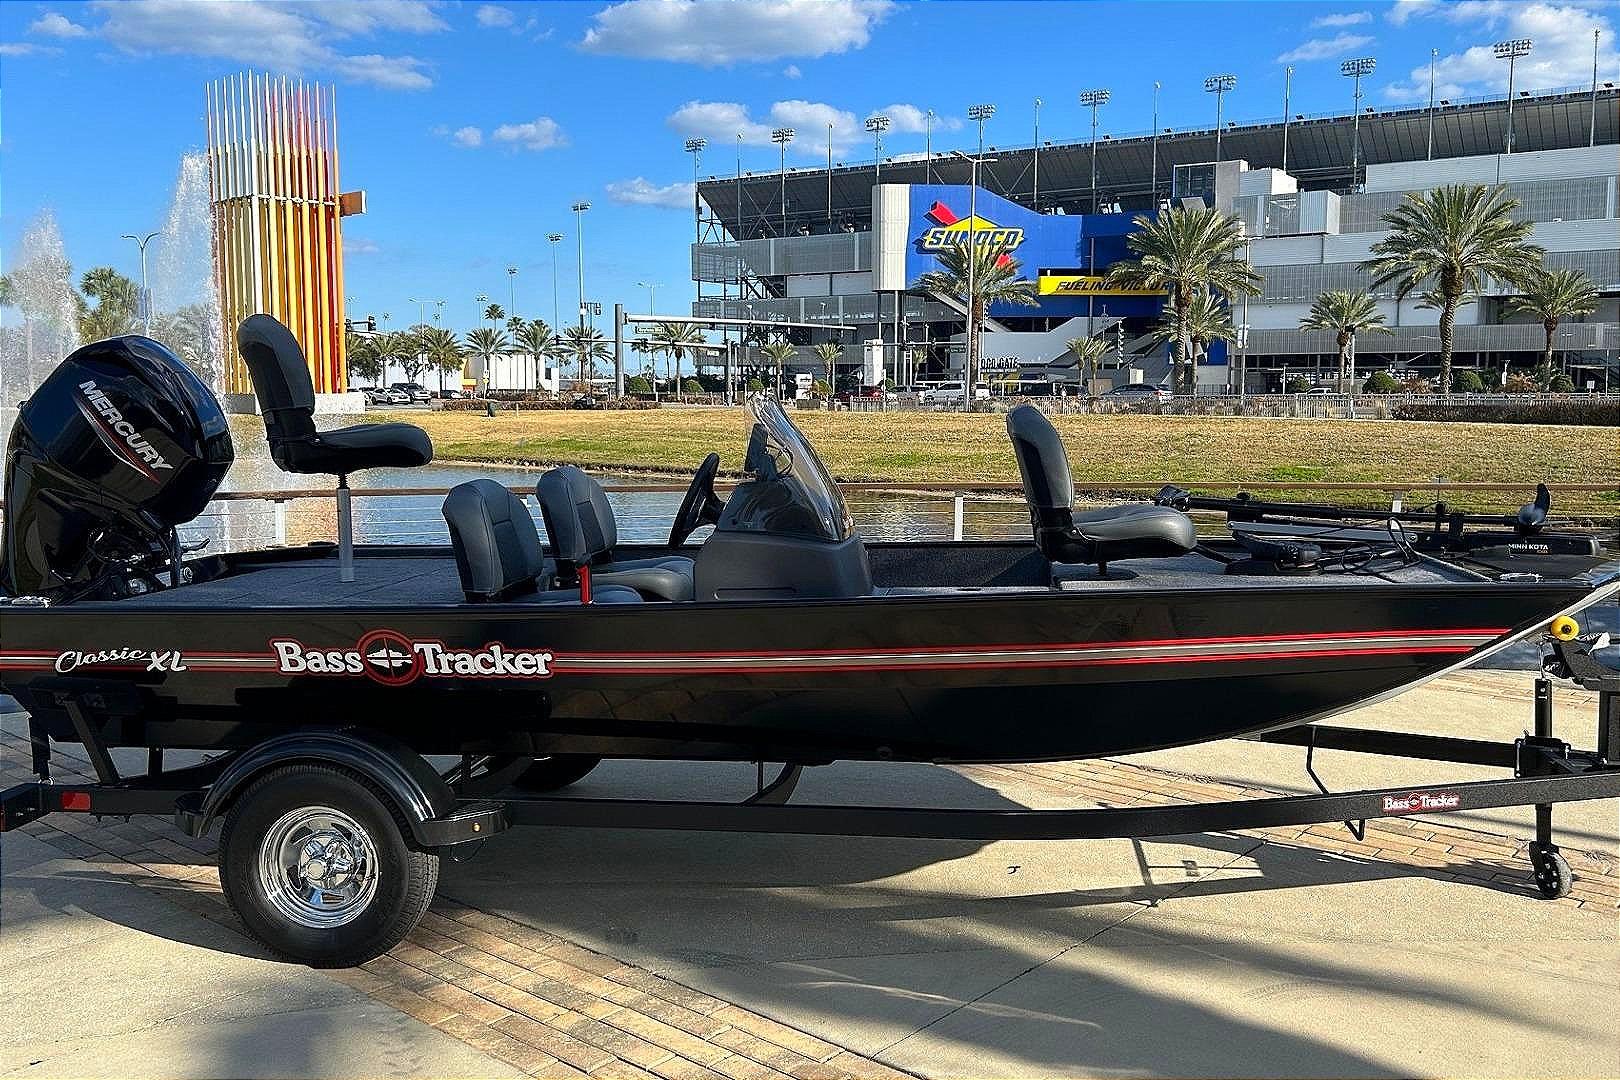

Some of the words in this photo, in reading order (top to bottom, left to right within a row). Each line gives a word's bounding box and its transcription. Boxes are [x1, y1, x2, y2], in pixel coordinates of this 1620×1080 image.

[931, 230, 1020, 246] SUNOCO
[1056, 280, 1112, 290] FUELING
[79, 380, 174, 469] MERCURY
[55, 647, 147, 673] Classic
[146, 651, 187, 672] XL
[274, 642, 364, 672] Bass
[414, 643, 552, 675] Tracker
[1383, 796, 1409, 810] Bass
[1420, 794, 1460, 808] Tracker
